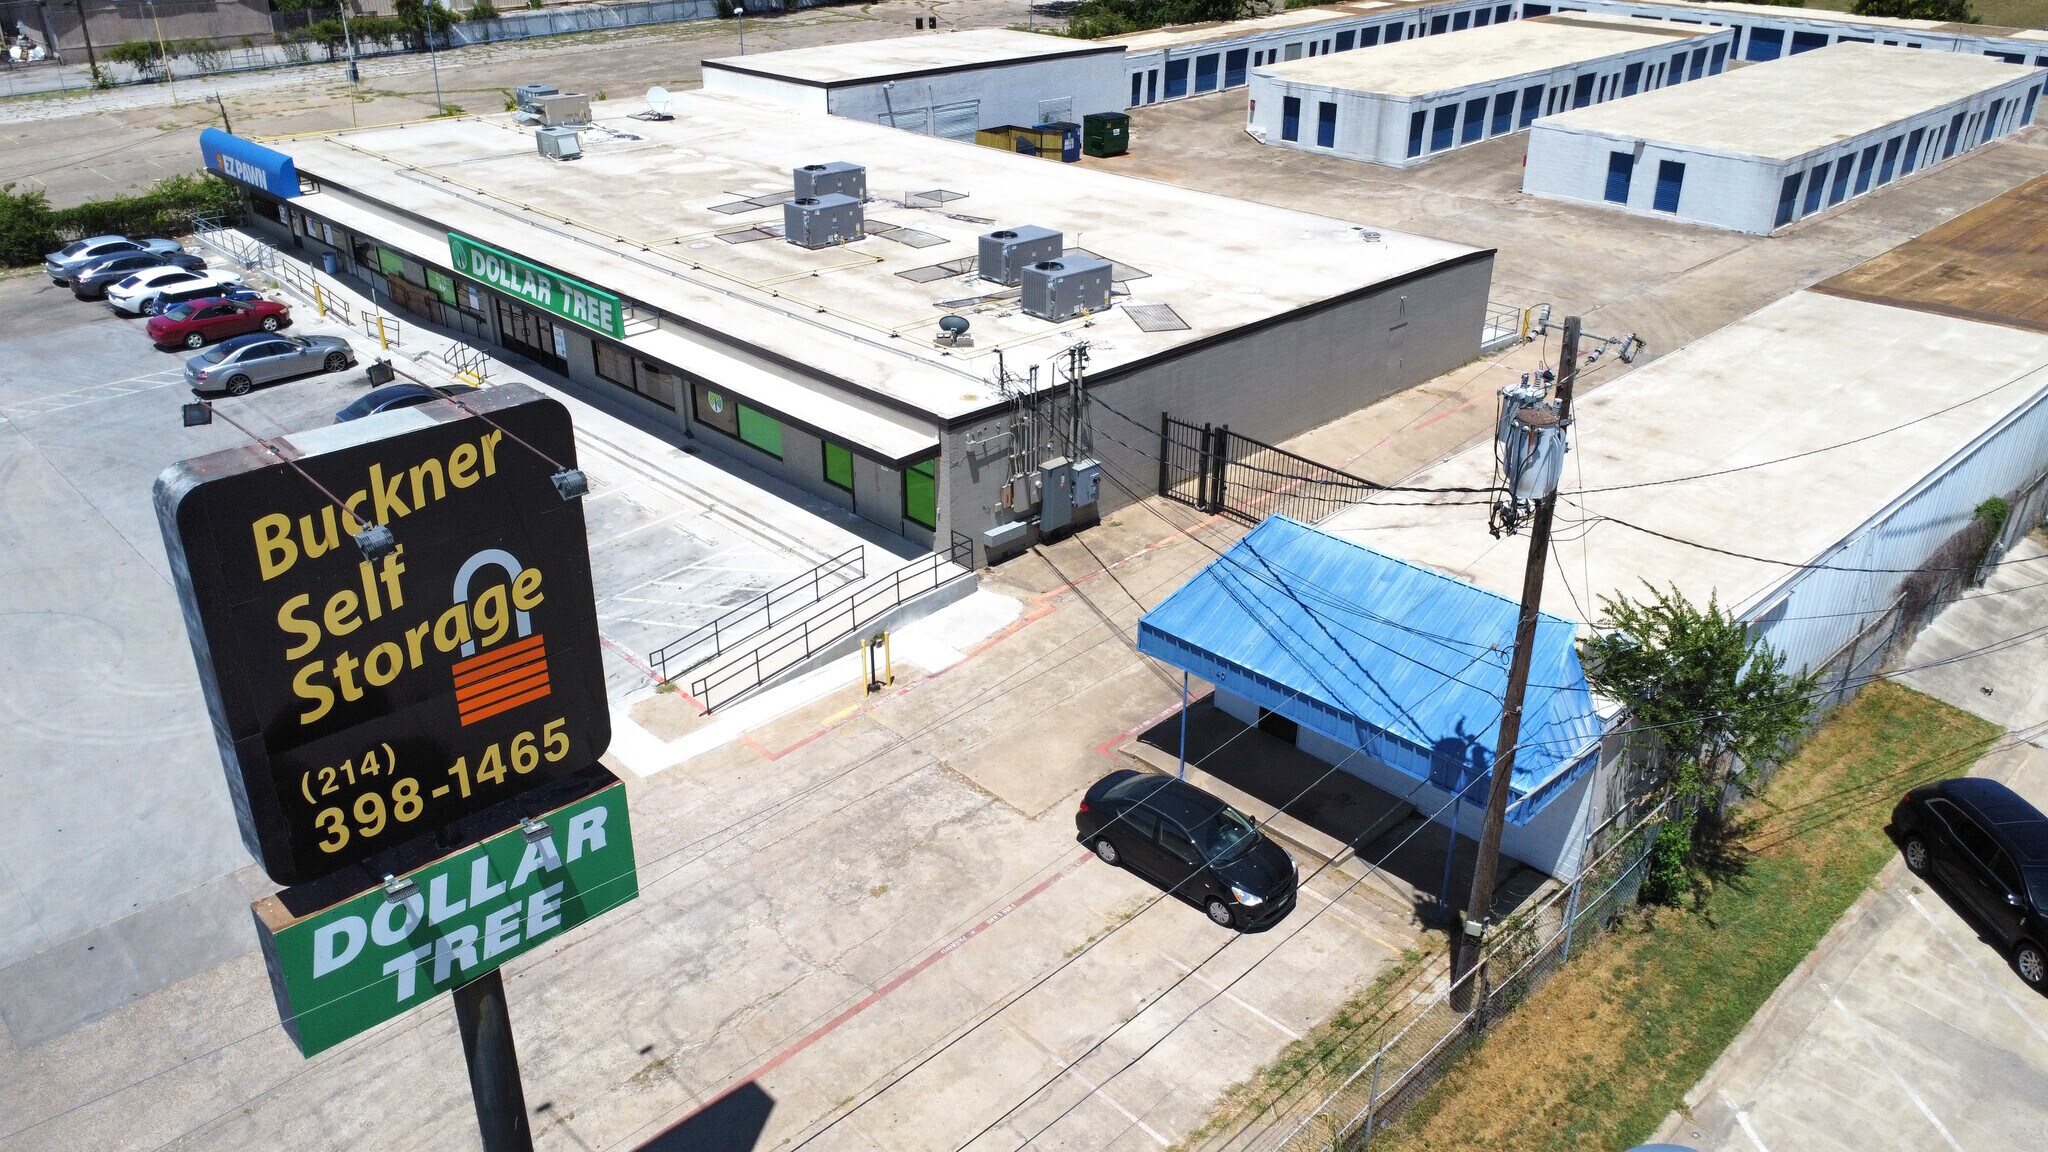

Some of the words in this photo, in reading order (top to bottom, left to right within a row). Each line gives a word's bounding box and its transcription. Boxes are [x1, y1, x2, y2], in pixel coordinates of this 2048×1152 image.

[470, 248, 552, 305] DOLLAR
[559, 282, 614, 333] TREE
[252, 428, 502, 581] Buckner
[277, 543, 405, 661] Self
[292, 567, 545, 725] Storage
[301, 743, 396, 804] (214)
[315, 718, 570, 853] 398-1465
[312, 805, 610, 980] DOLLAR
[381, 880, 565, 1004] TREE
